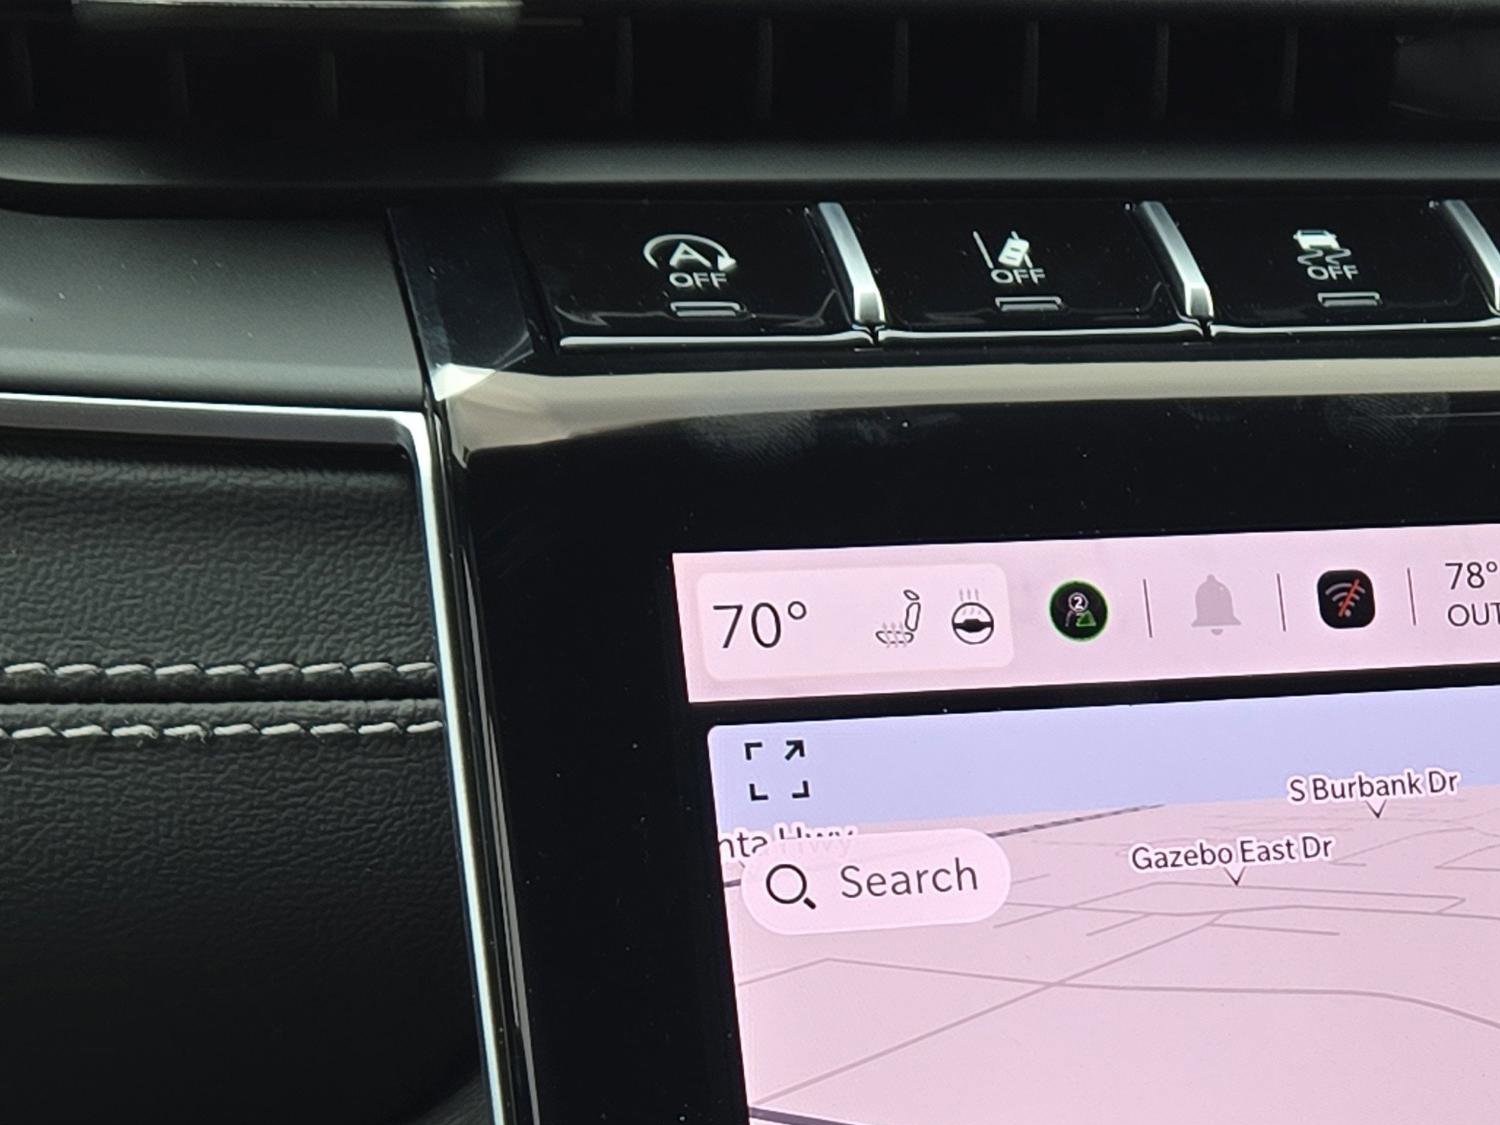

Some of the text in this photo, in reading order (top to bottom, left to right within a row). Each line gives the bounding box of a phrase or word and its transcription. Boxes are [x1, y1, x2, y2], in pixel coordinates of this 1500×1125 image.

[669, 272, 727, 289] OFF
[991, 268, 1046, 285] OFF
[1307, 264, 1358, 281] OFF
[1445, 560, 1498, 591] 78°
[713, 601, 807, 648] 70°
[1290, 771, 1458, 802] S Burbank Dr
[1132, 836, 1333, 869] Gazebo East Dr
[840, 857, 978, 898] Search
